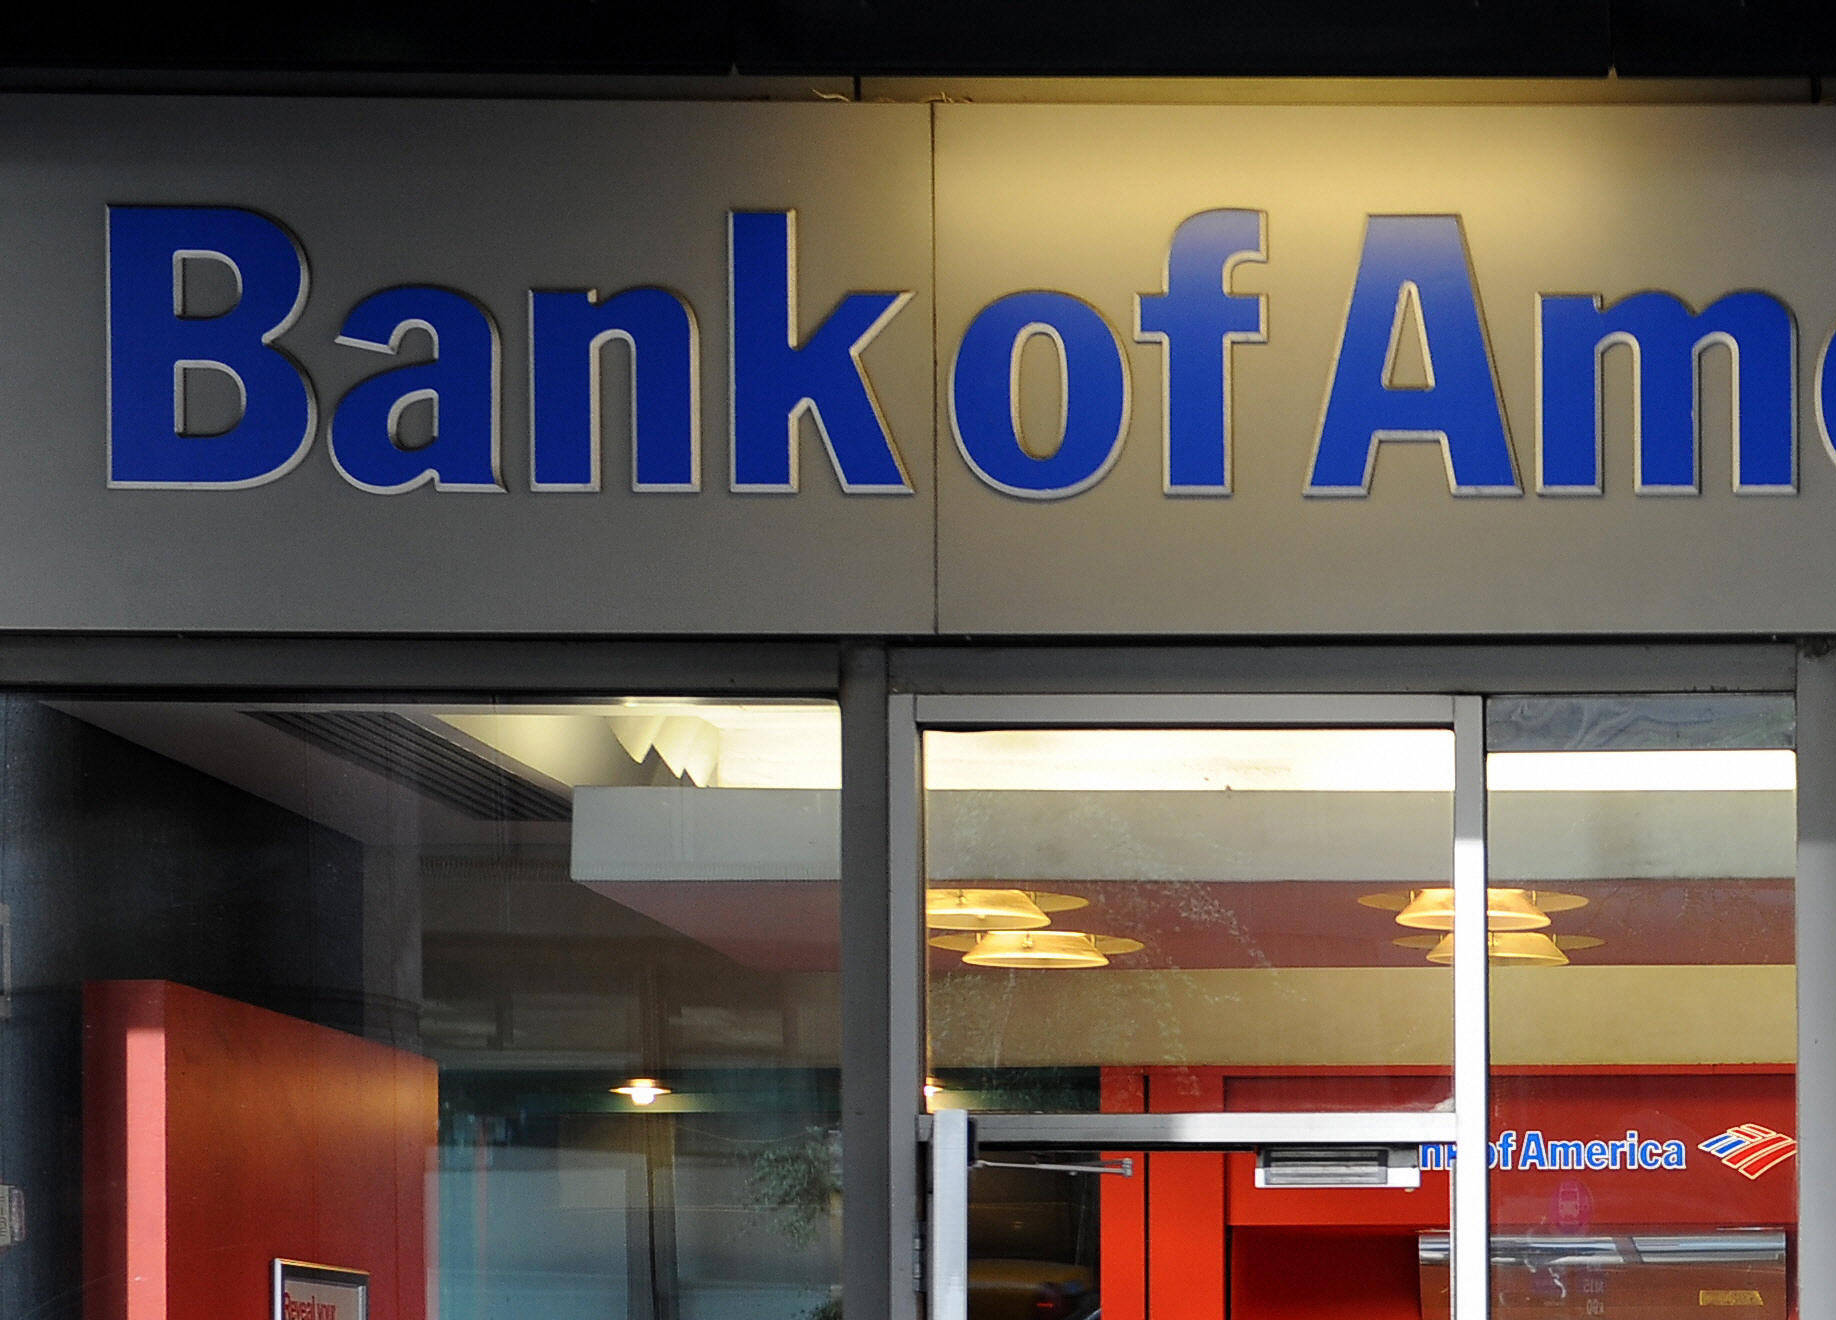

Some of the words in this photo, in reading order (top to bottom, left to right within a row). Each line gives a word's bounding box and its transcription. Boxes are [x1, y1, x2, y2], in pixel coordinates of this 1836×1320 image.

[106, 204, 915, 494] Bank
[948, 209, 1268, 499] of
[1518, 1130, 1686, 1170] America
